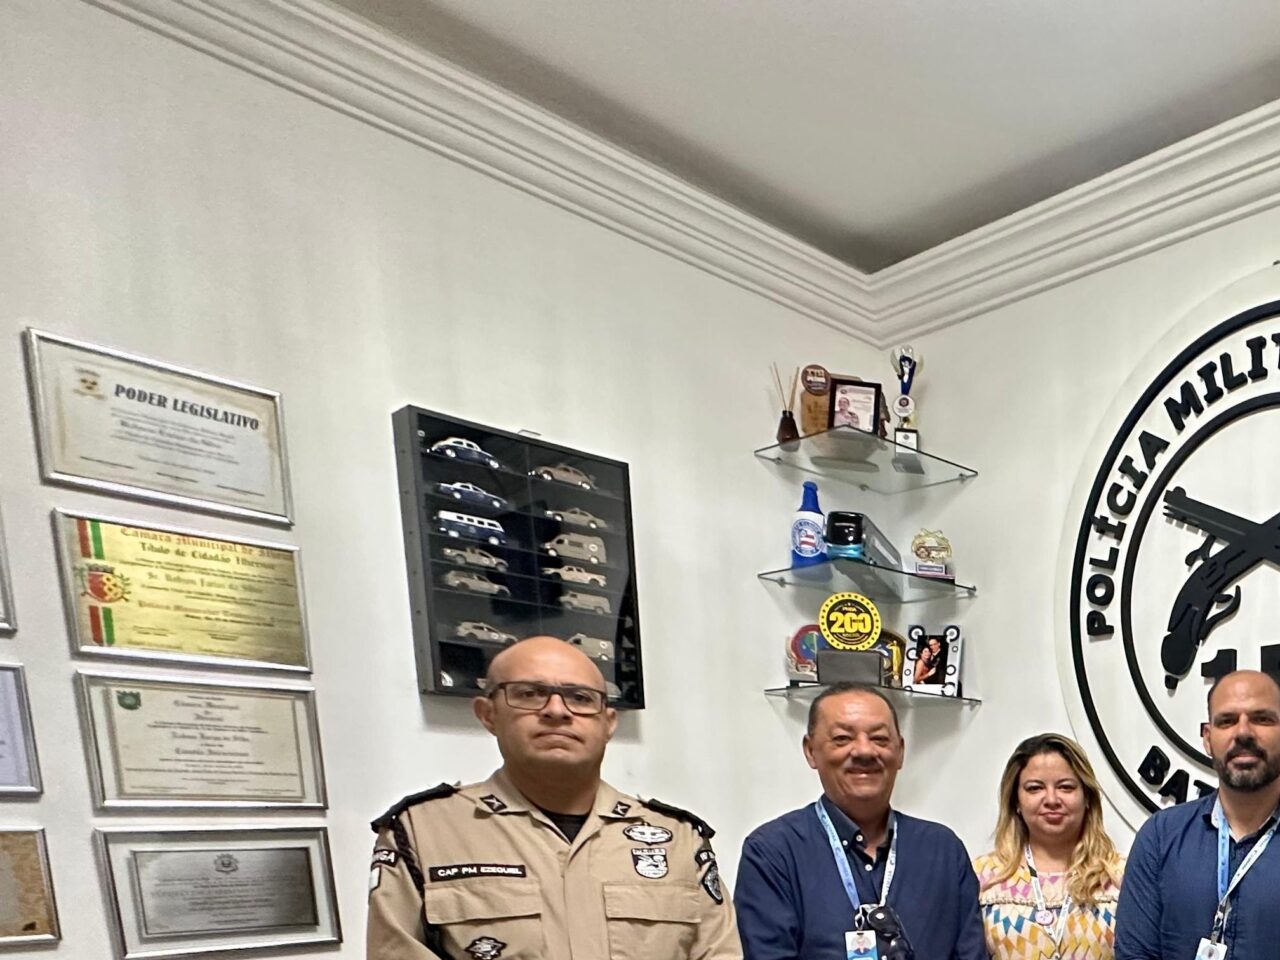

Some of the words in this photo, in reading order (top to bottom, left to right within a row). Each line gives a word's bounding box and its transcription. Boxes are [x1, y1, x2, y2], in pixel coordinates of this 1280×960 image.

[114, 383, 168, 408] PODER
[172, 398, 259, 430] LEGISLATIVO
[829, 611, 872, 634] 200
[437, 868, 459, 877] CAP
[461, 866, 477, 874] PM
